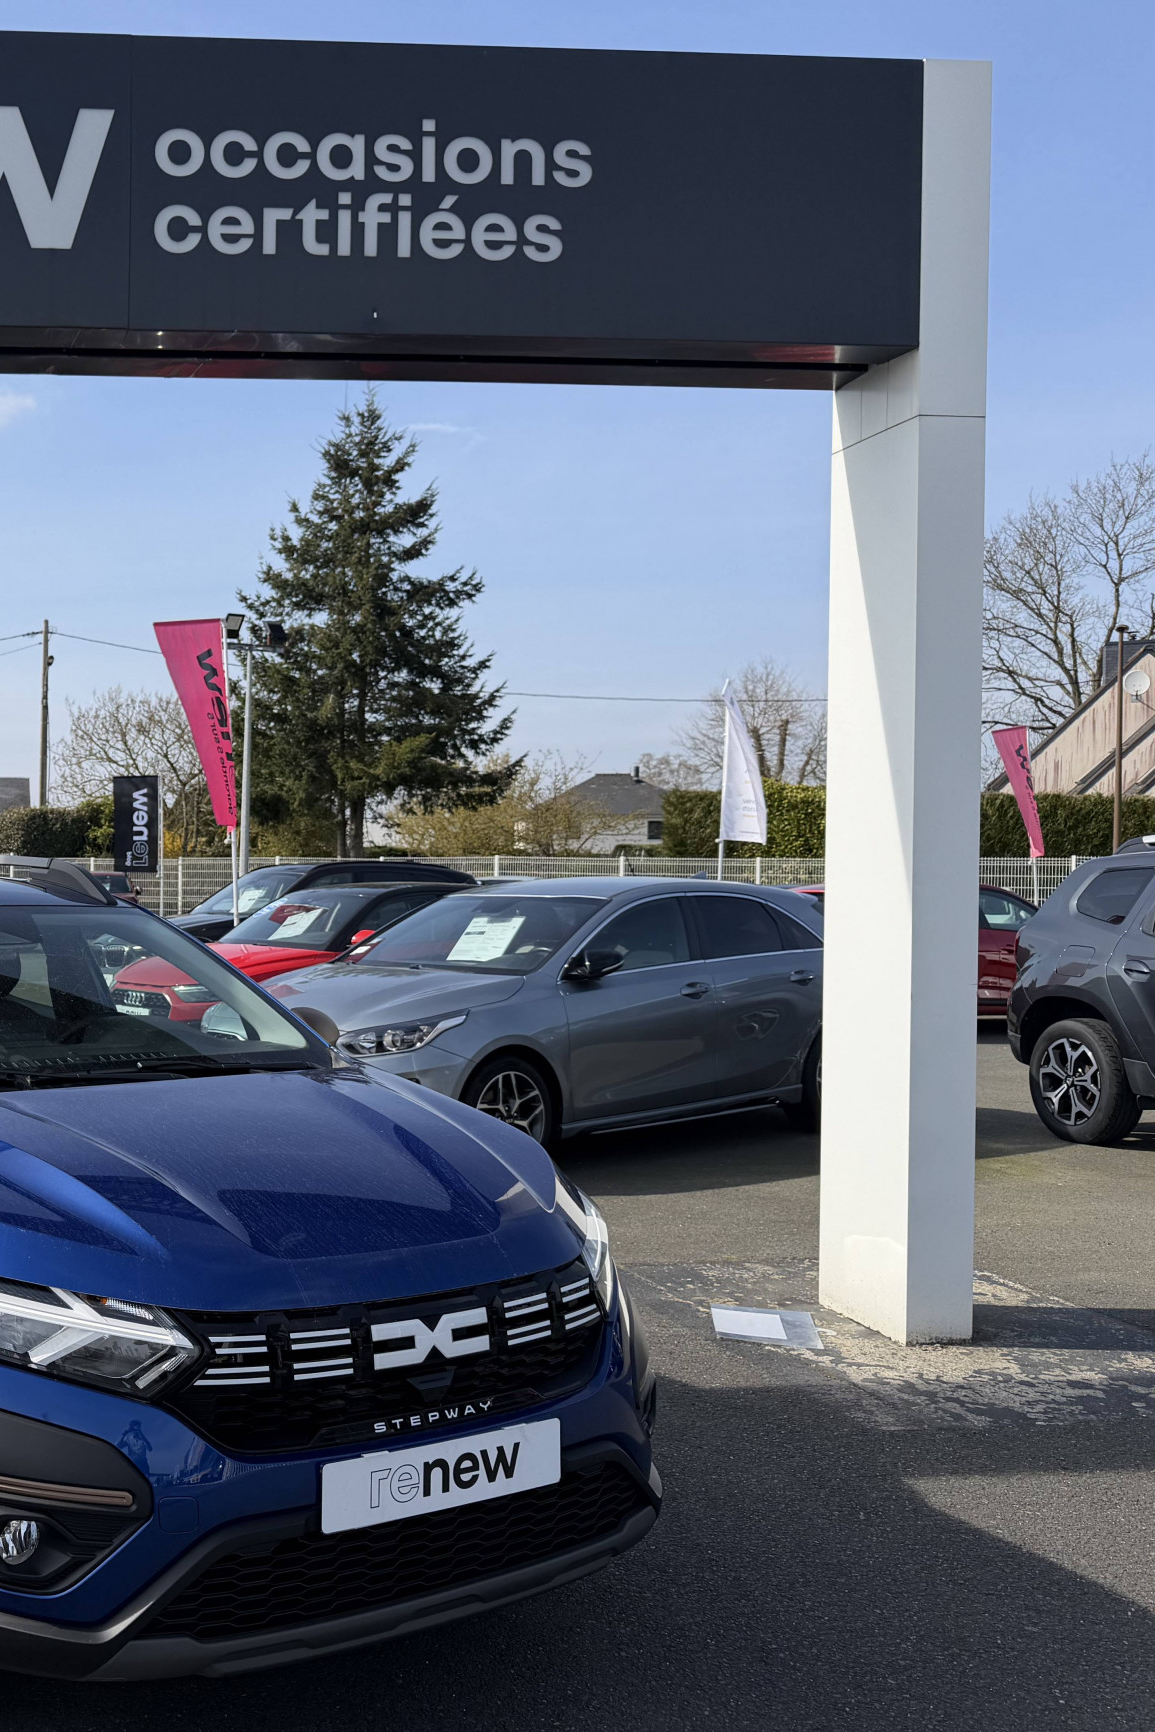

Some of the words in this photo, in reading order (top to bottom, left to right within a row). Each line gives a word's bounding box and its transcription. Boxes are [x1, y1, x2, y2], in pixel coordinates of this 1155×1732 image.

[154, 118, 594, 188] occasions
[153, 191, 564, 263] certifiées
[373, 1399, 493, 1434] STEPWAY
[369, 1441, 521, 1510] renew
